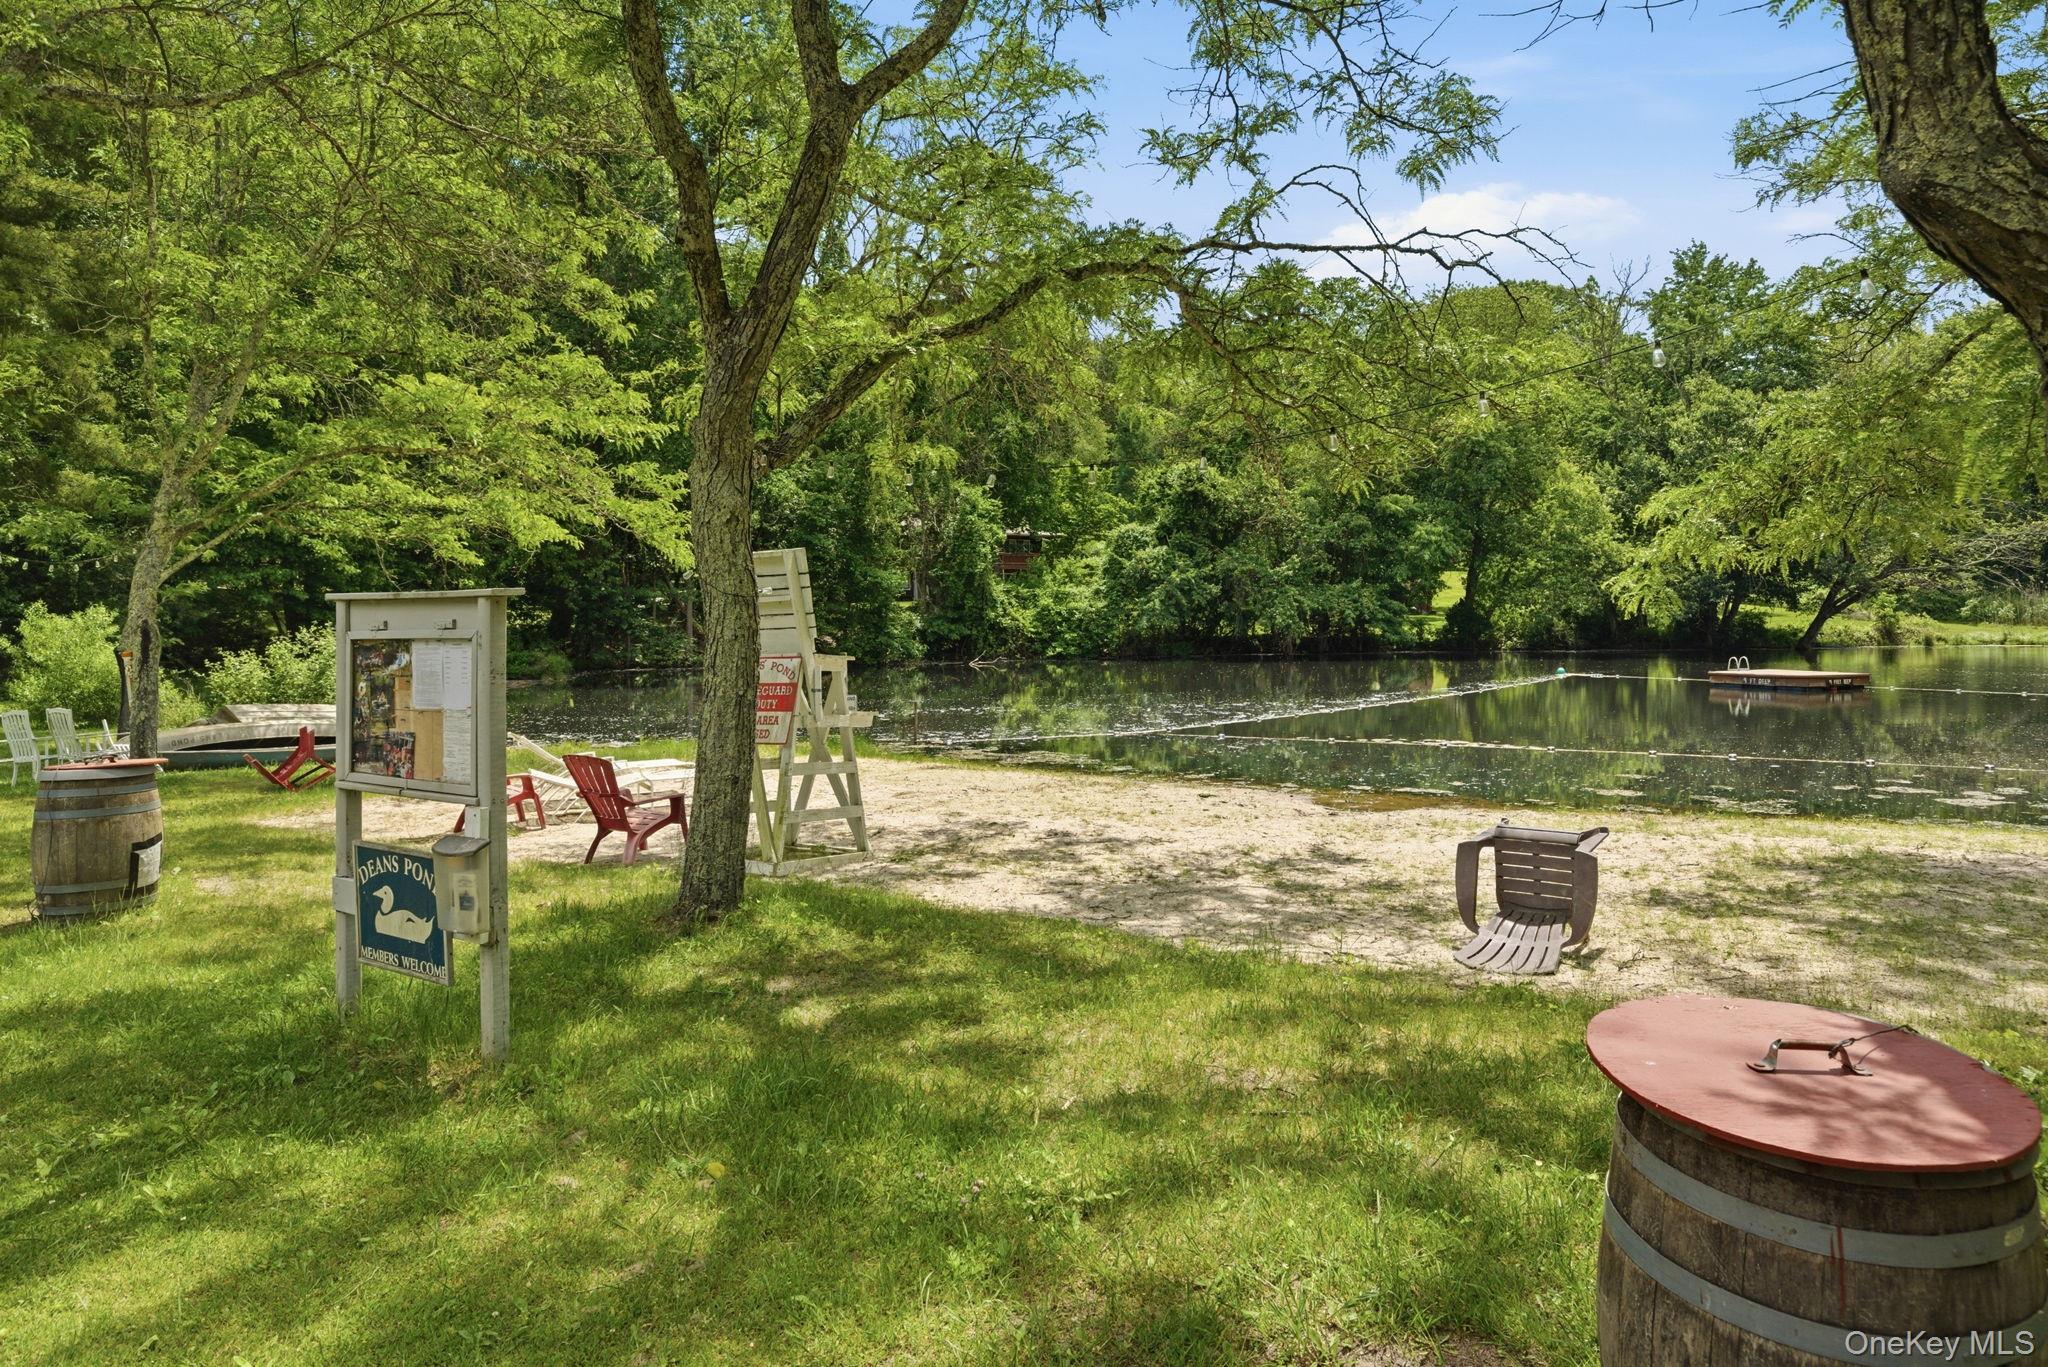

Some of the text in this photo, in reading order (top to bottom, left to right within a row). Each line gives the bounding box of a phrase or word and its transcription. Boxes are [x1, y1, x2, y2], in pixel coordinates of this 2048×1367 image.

[771, 661, 795, 681] POND
[757, 715, 779, 726] AREA
[358, 854, 399, 884] DEANS
[404, 857, 437, 896] PON
[361, 945, 447, 978] MEMBERS WELCOME
